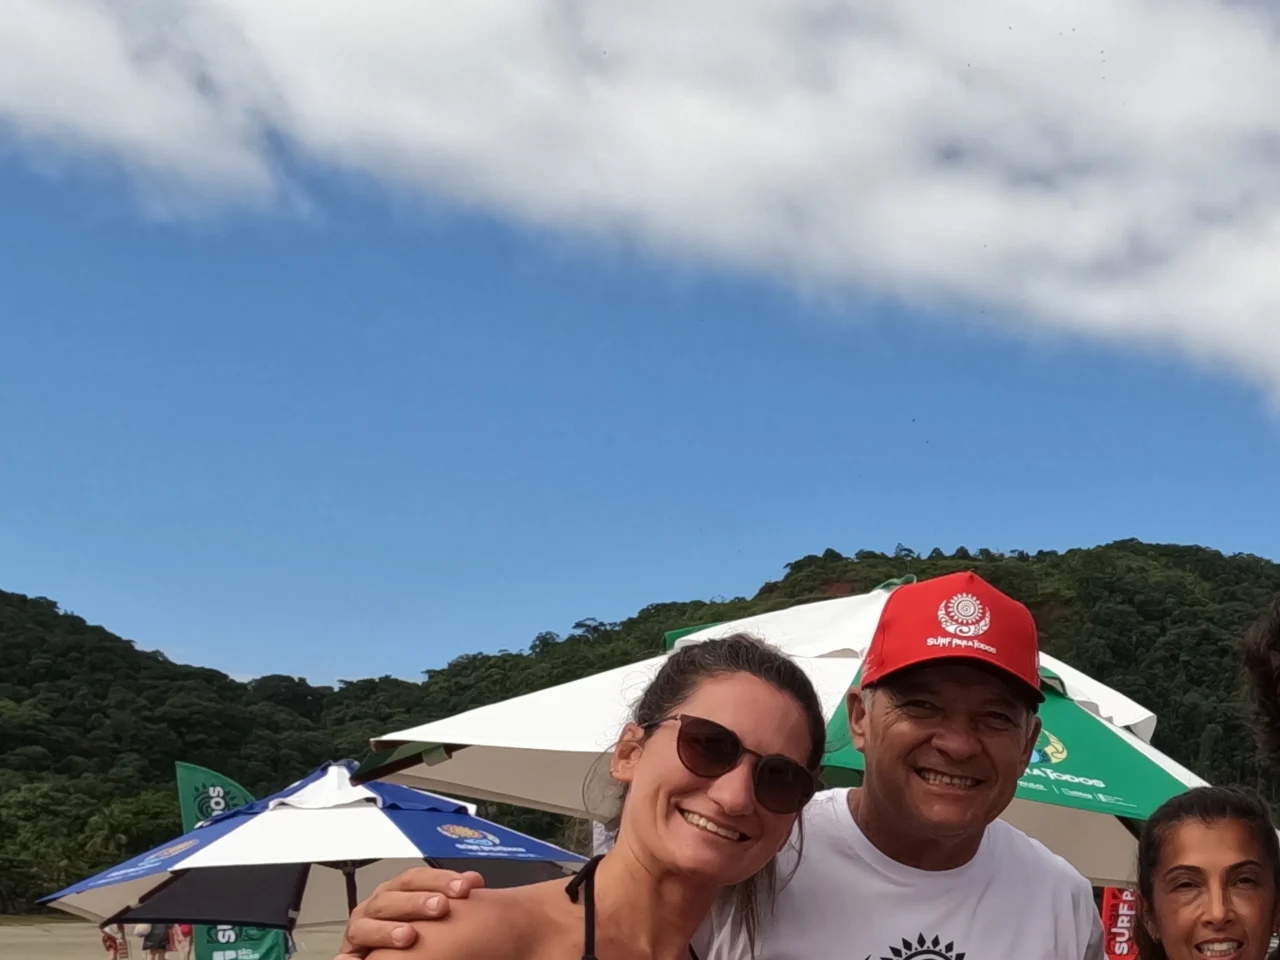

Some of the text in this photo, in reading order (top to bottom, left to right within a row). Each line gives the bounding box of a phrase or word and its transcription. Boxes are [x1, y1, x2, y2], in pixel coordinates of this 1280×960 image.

[926, 636, 997, 654] SURF PARA TODOS
[1041, 767, 1106, 788] TODOS
[1110, 902, 1136, 955] SURF
